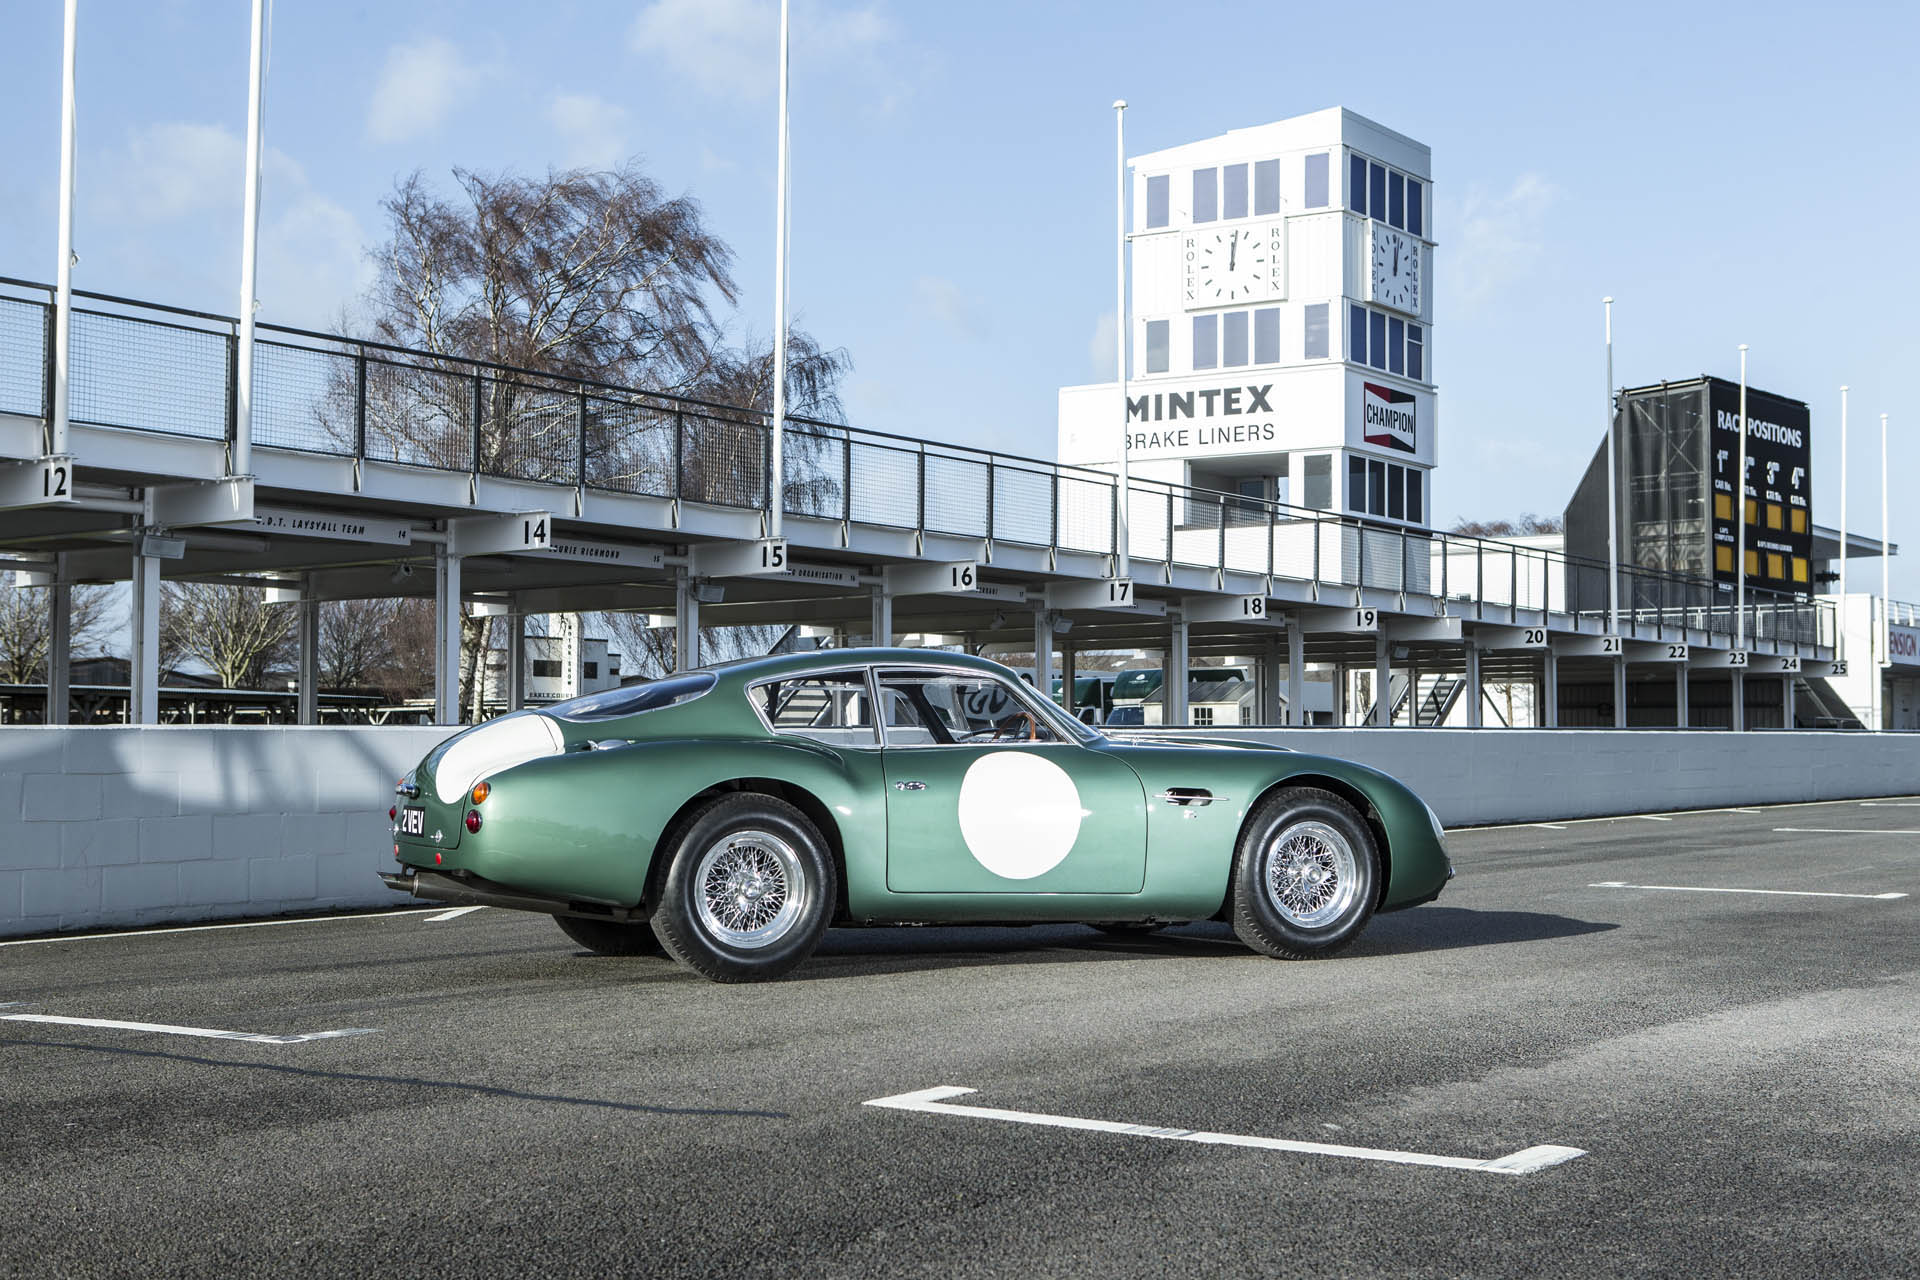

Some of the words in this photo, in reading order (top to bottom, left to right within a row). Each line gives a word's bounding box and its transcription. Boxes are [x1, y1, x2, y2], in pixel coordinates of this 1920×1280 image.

[1271, 228, 1280, 291] ROLEX
[1186, 238, 1195, 301] ROLEX
[1127, 384, 1274, 423] MINTEX
[1366, 403, 1414, 434] CHAMPION
[1127, 430, 1190, 450] BRAKE
[1199, 423, 1275, 445] LINERS
[1717, 409, 1741, 433] RAC
[1747, 417, 1802, 448] POSITIONS
[44, 467, 67, 497] 12
[342, 524, 365, 535] TEAM
[398, 530, 407, 539] 14
[524, 519, 546, 544] 14
[581, 547, 620, 559] RICHMOND
[763, 546, 783, 567] 15
[953, 566, 973, 587] 16
[1110, 583, 1129, 601] 17
[1243, 598, 1262, 615] 18
[1356, 611, 1374, 627] 19
[1525, 630, 1544, 644] 20
[1603, 638, 1620, 651] 21
[1889, 631, 1917, 657] ENSIGN
[1668, 645, 1686, 658] 22
[1729, 652, 1745, 665] 23
[1781, 658, 1797, 670] 24
[1832, 663, 1847, 674] 25
[402, 810, 407, 832] 2
[407, 809, 424, 834] VEV
